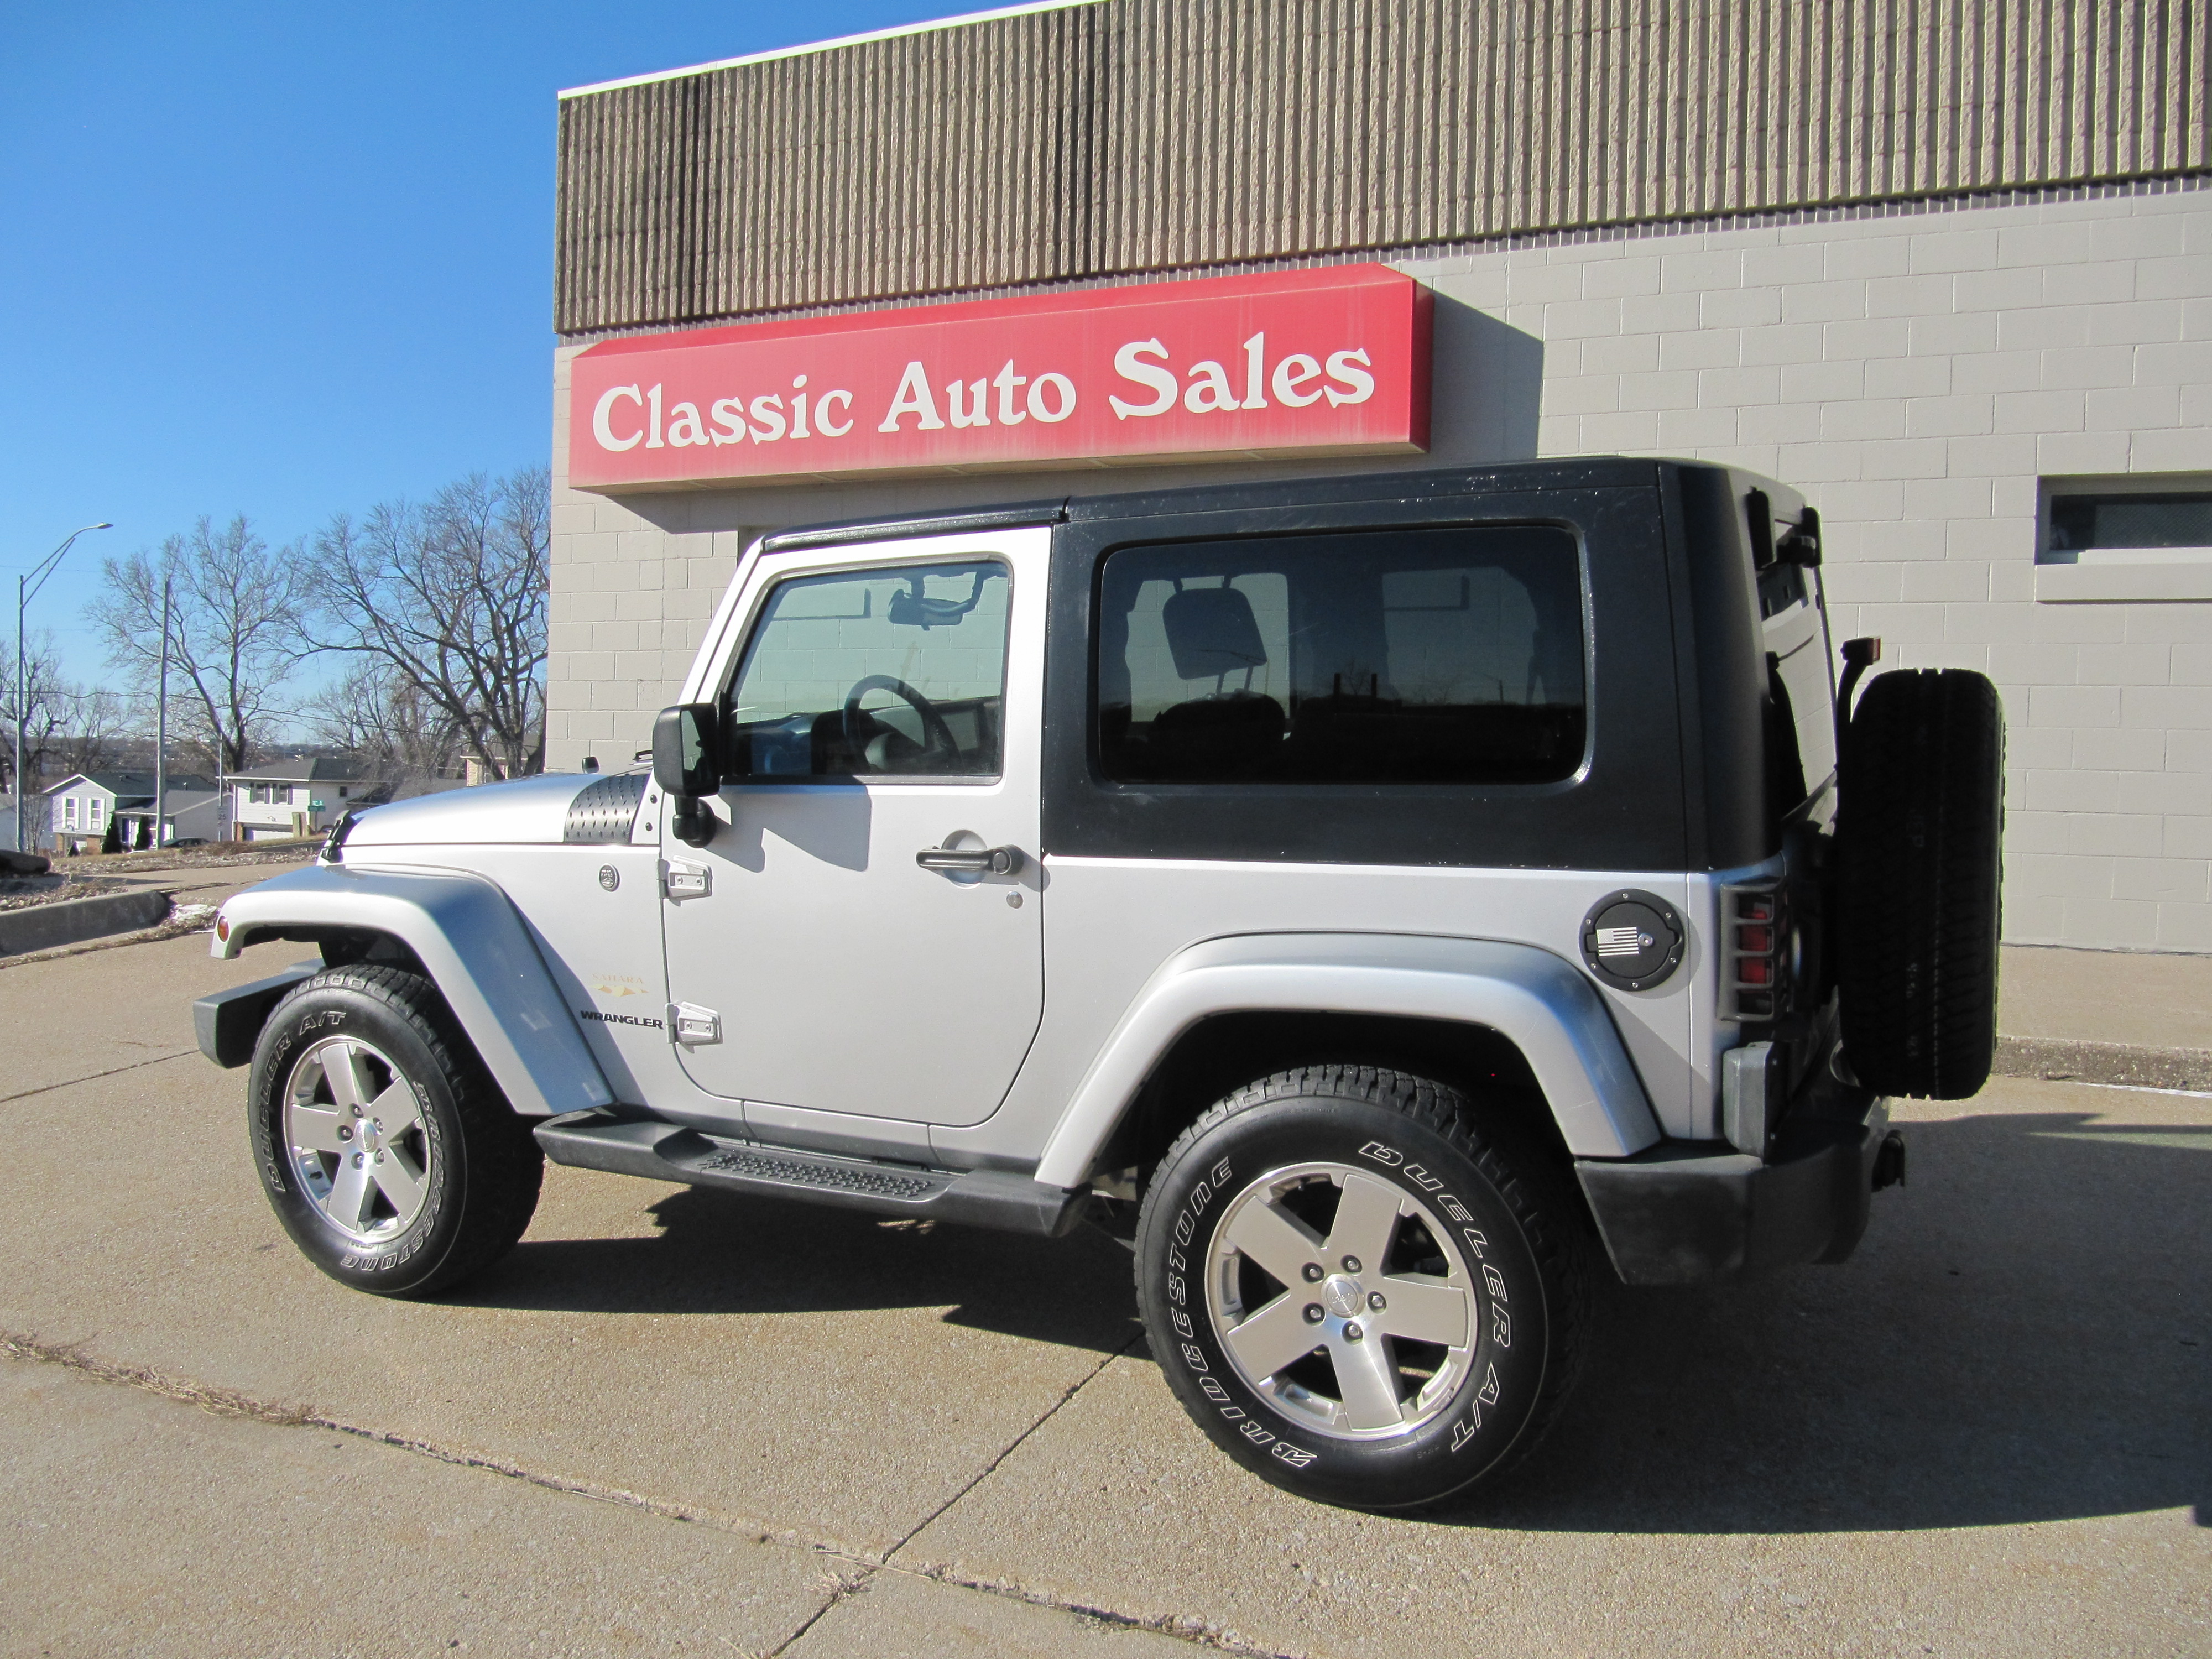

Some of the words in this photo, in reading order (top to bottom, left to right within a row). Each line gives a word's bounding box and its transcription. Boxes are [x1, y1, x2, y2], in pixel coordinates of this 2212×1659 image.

[592, 374, 854, 452] Classic
[878, 359, 1077, 434] Auto
[1108, 331, 1376, 421] Sales
[258, 1033, 291, 1192] DUELER
[299, 1010, 346, 1035] A/T
[580, 1010, 664, 1030] WRANGLER
[1168, 1155, 1319, 1468] BRIDGESTONE
[1358, 1141, 1512, 1348] DUELER
[1451, 1361, 1501, 1453] A/T
